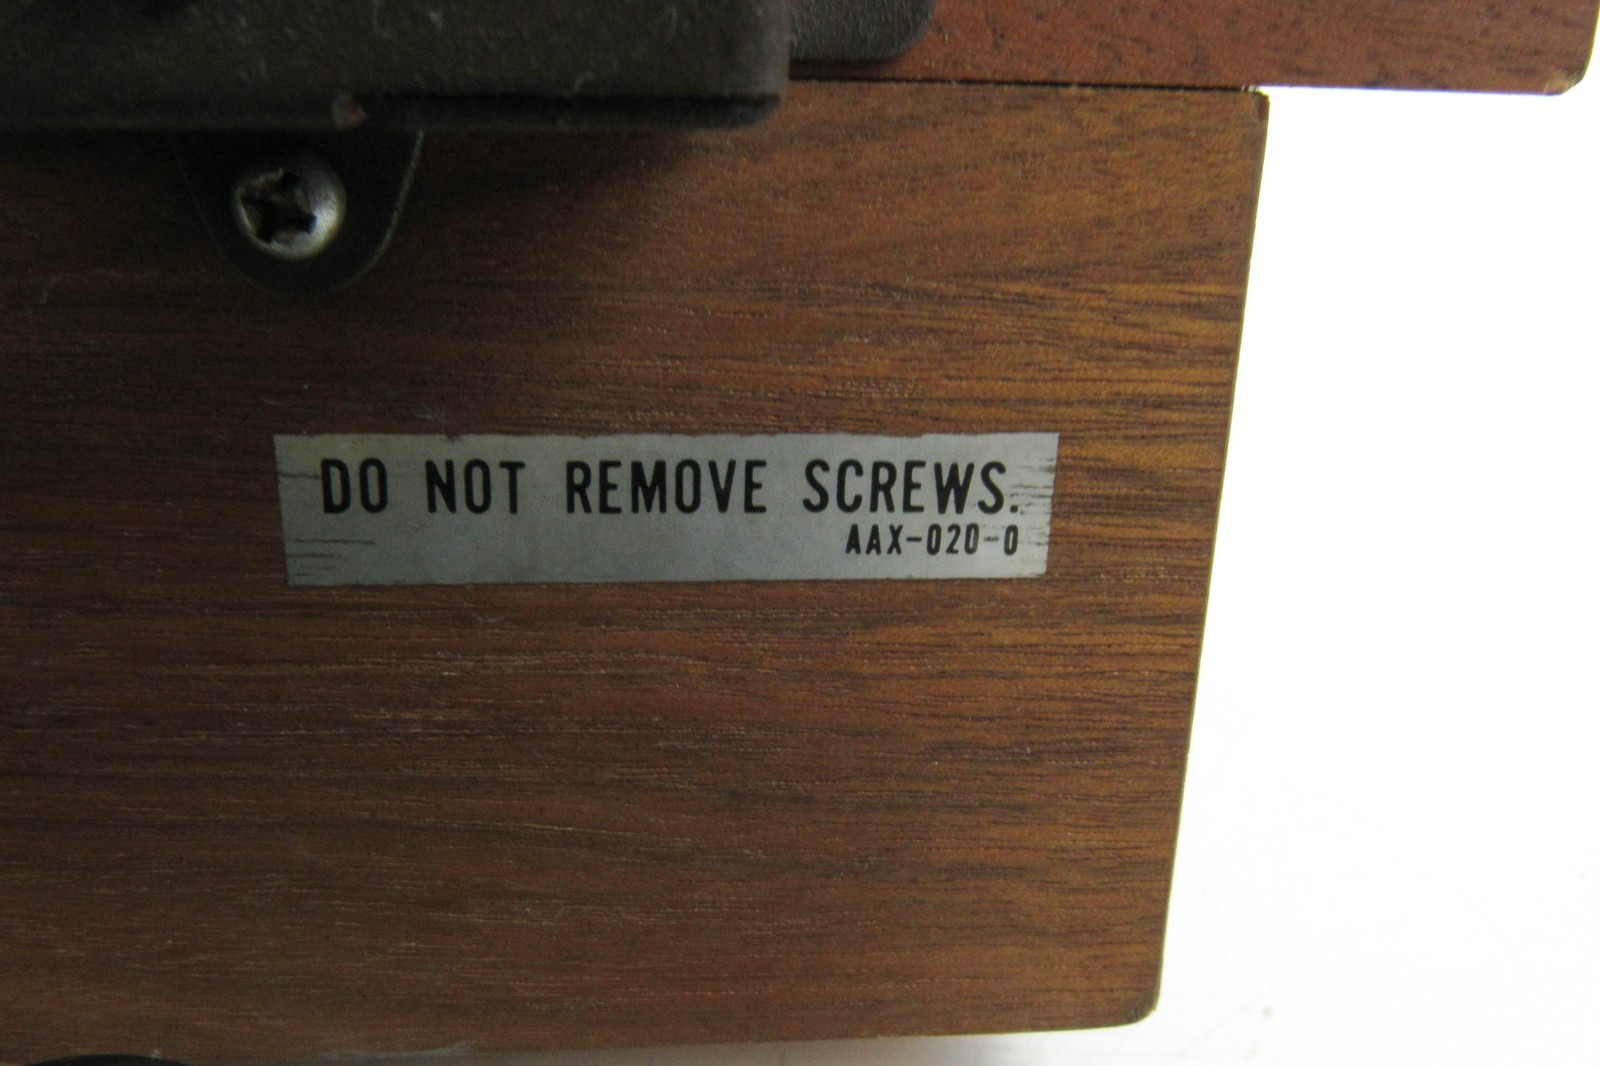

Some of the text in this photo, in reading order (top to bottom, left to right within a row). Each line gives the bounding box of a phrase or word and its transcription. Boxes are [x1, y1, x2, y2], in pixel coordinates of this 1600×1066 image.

[321, 457, 1021, 516] DO NOT REMOVE SCREWS.
[844, 522, 1019, 557] AAX-020-0
